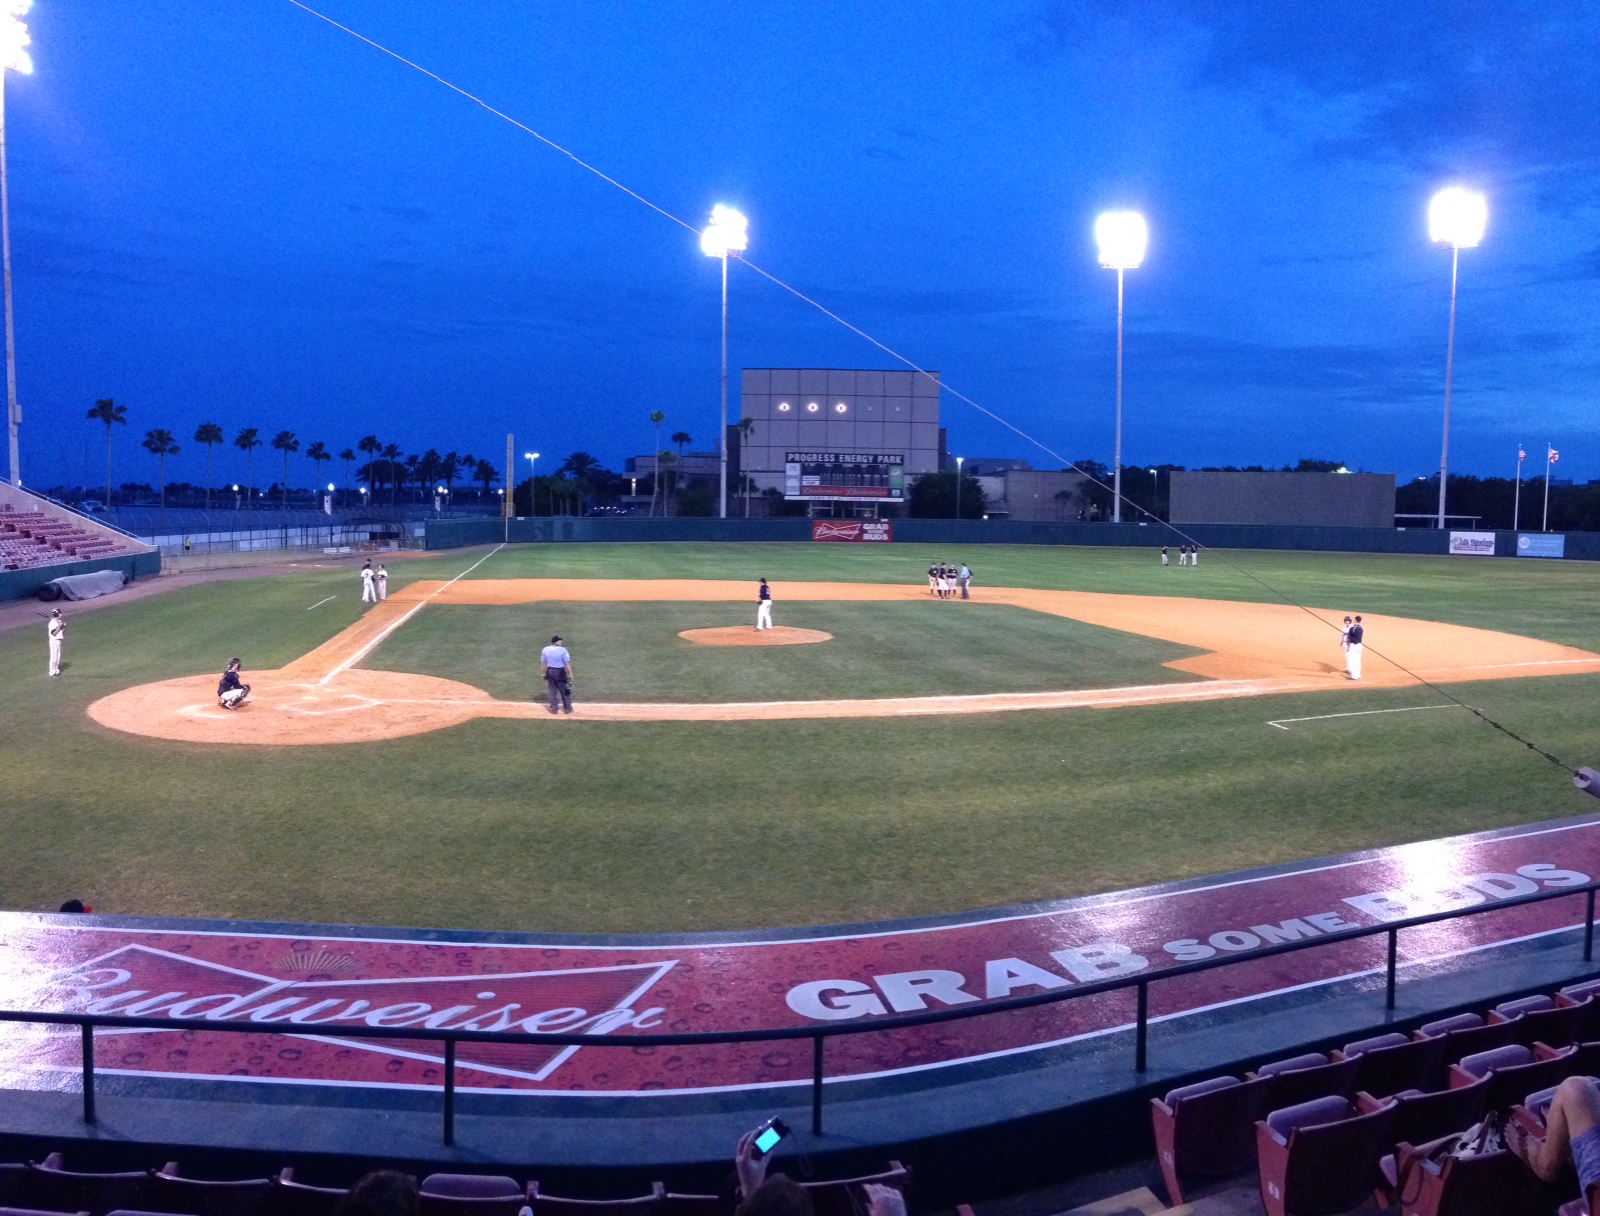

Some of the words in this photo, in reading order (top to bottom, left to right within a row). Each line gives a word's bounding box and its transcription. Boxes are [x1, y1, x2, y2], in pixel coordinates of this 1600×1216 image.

[788, 453, 835, 462] PROGRESS
[839, 454, 874, 463] ENERGY
[877, 455, 902, 464] PARK
[785, 942, 1149, 1021] GRAB
[1163, 911, 1358, 963] SOME
[52, 967, 665, 1035] Budweiser
